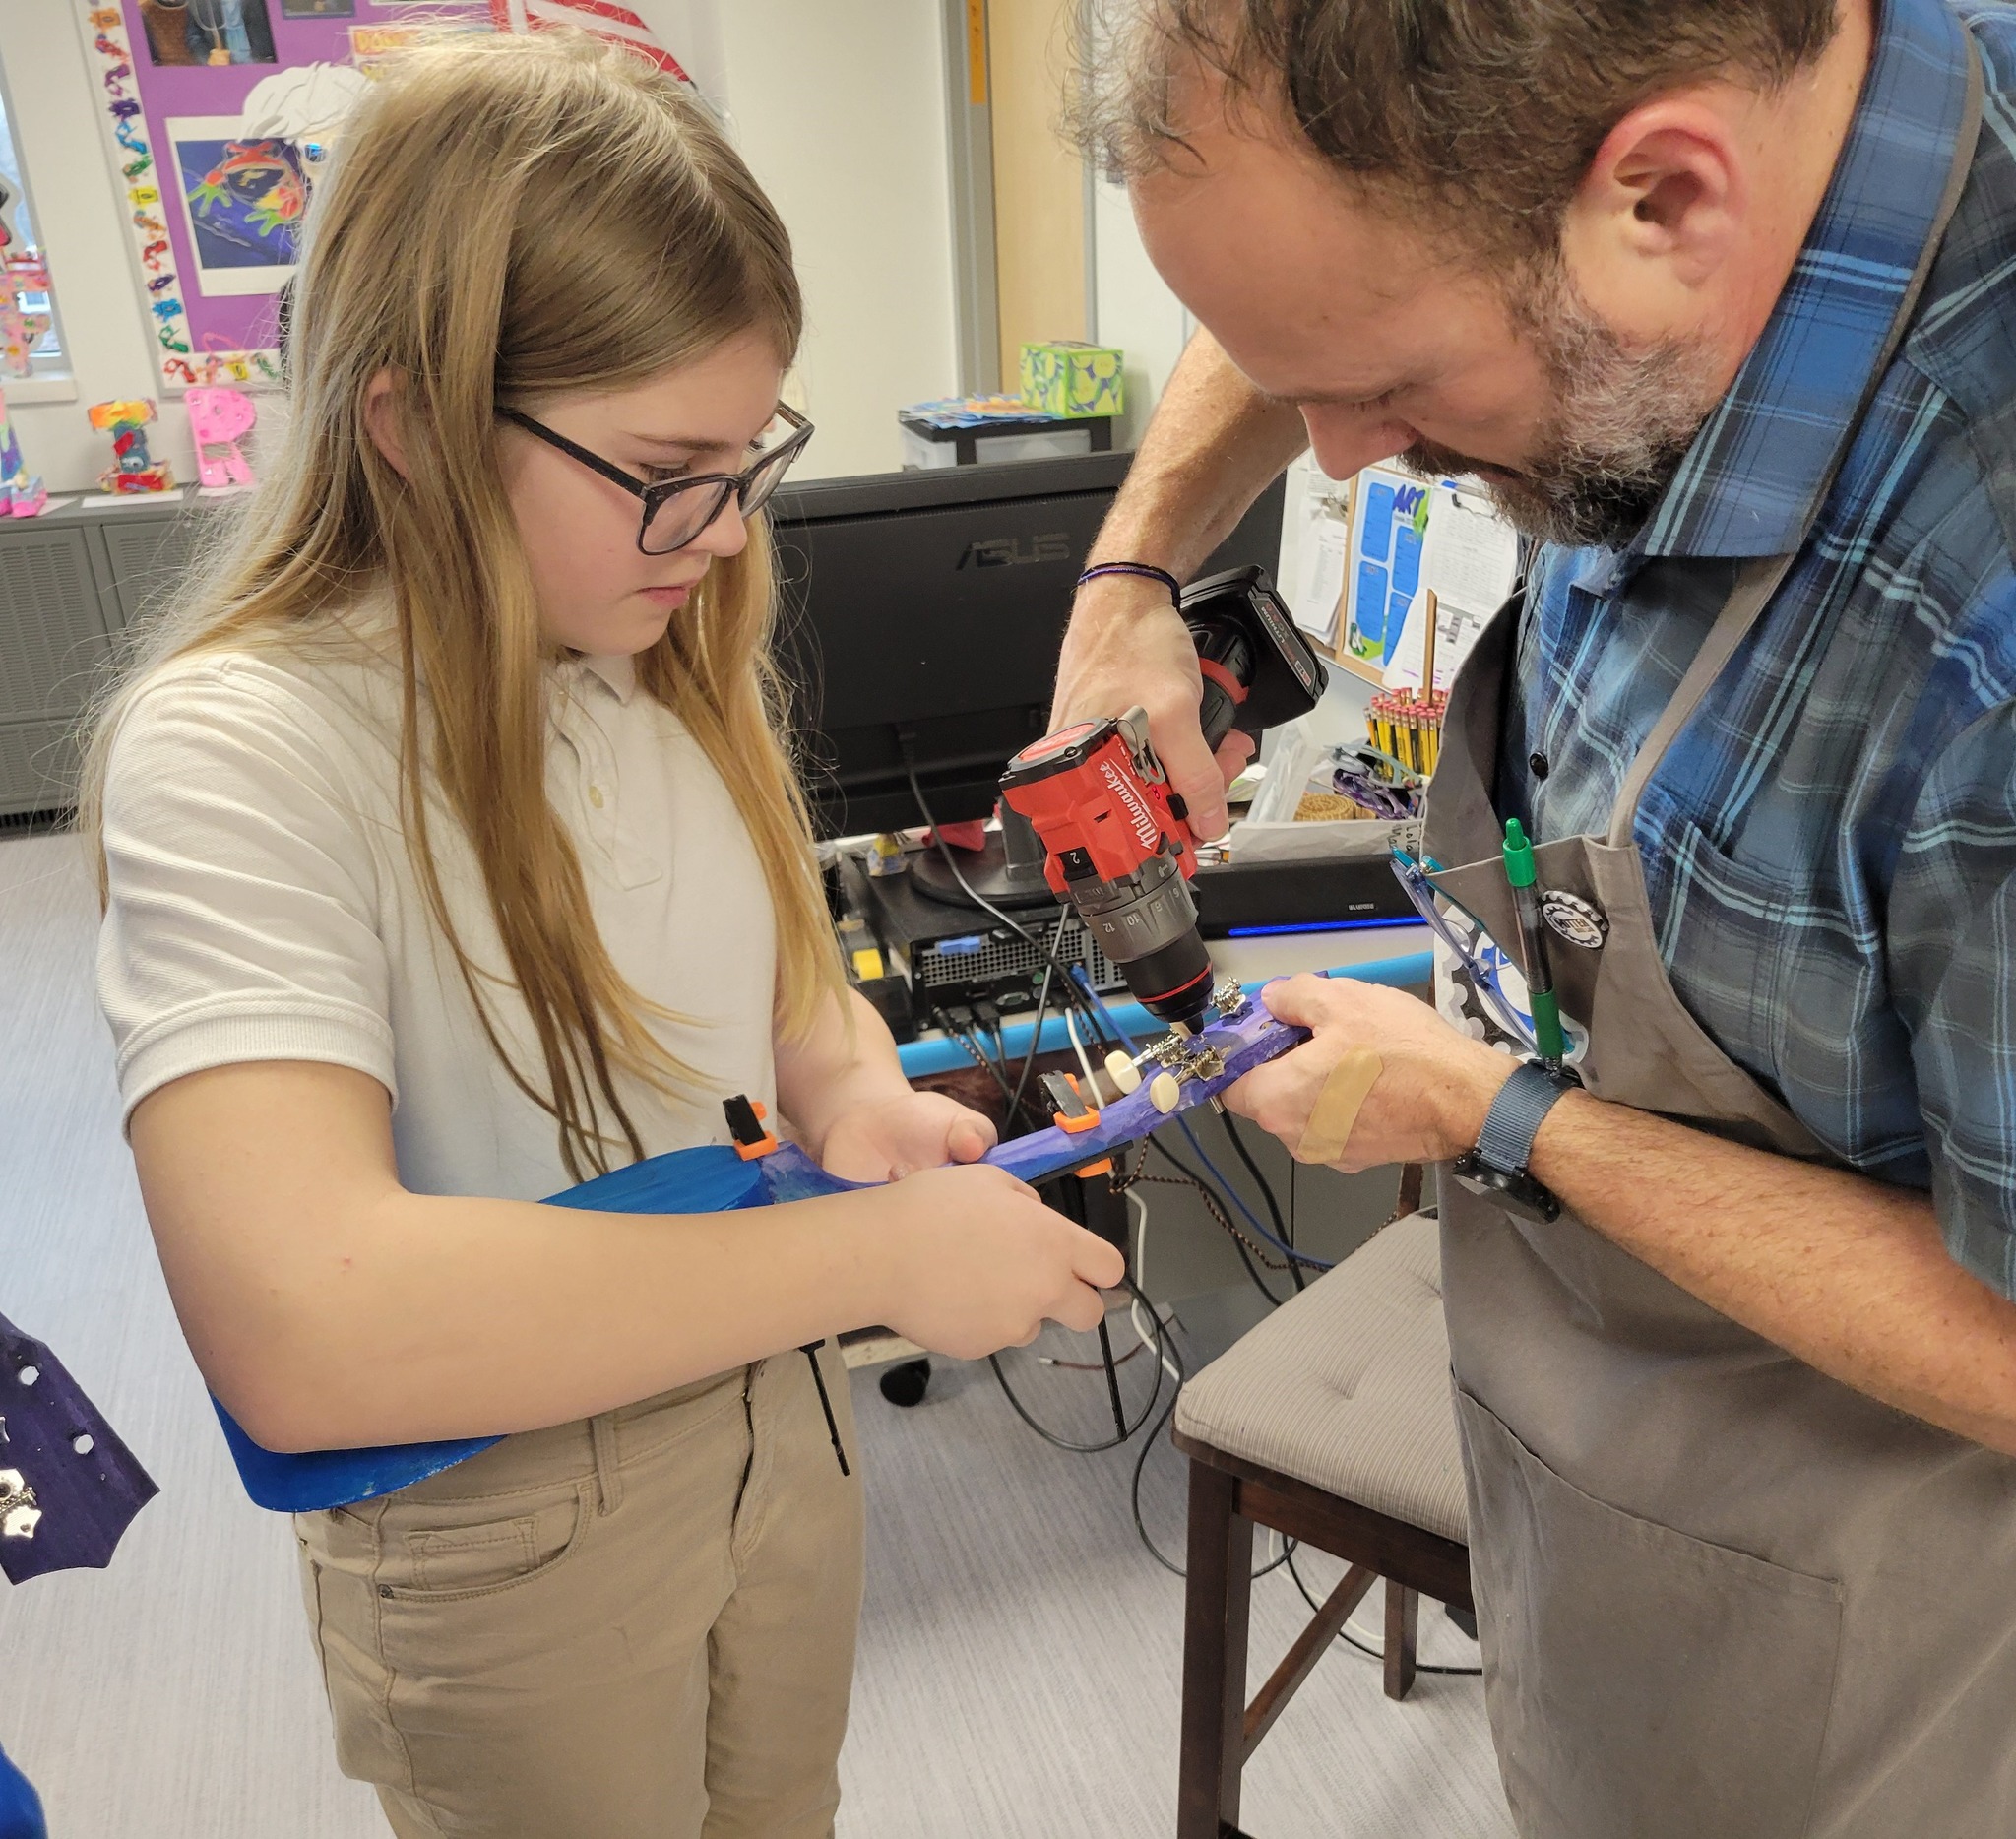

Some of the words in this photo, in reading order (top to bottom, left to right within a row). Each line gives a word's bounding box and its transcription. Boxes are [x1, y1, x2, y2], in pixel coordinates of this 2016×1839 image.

[1392, 483, 1426, 518] ART
[956, 533, 1071, 571] ASUS
[1099, 761, 1158, 850] Milwaukee
[1069, 851, 1081, 864] 2
[1102, 921, 1116, 933] 12
[1125, 913, 1140, 927] 10
